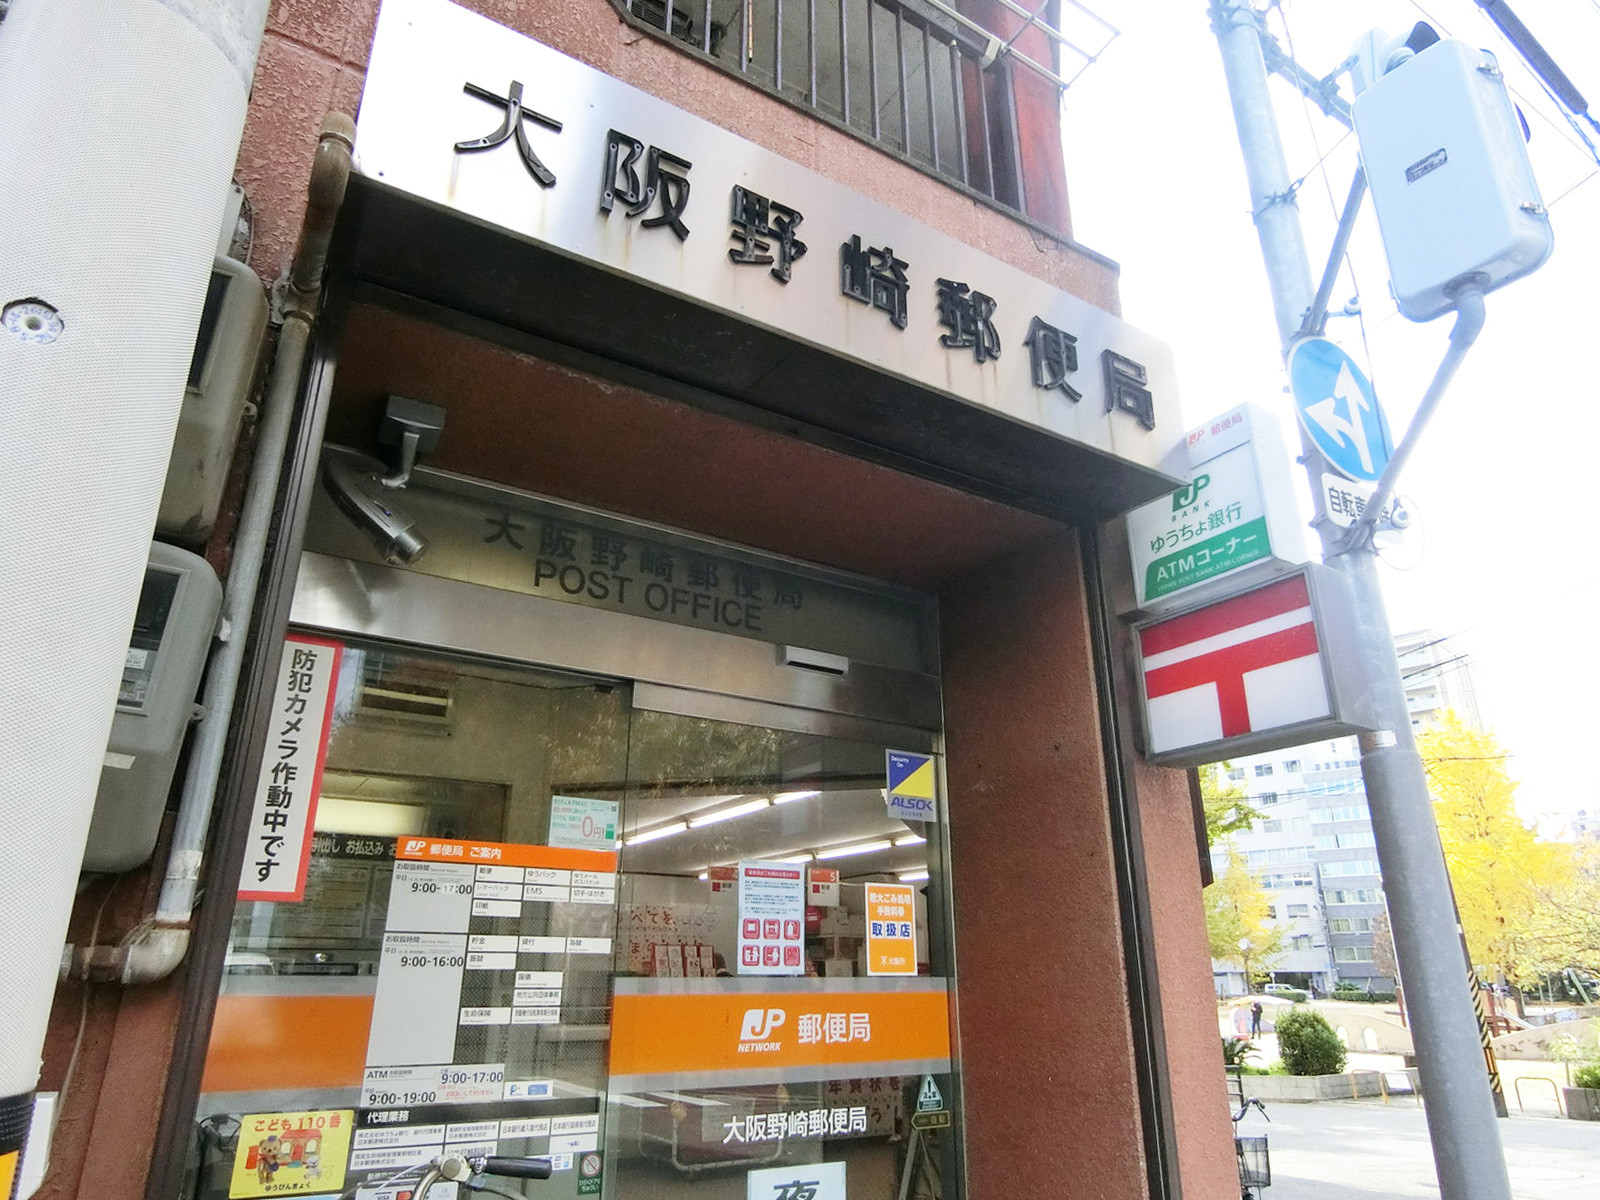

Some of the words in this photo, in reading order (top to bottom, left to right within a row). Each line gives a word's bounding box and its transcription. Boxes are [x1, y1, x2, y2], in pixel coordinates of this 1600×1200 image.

[453, 80, 1156, 432] 大阪野崎郵便局
[1171, 500, 1210, 522] BANK
[1150, 501, 1243, 555] ゆうちょ銀行
[483, 512, 804, 610] 大阪野崎郵便局
[1156, 533, 1258, 583] ATMコーナー
[533, 558, 634, 604] POST
[644, 582, 763, 632] OFFICE
[254, 648, 318, 883] 防犯カメラ作動中です
[890, 796, 934, 811] ALSOK
[345, 839, 385, 856] お払込み
[429, 843, 464, 856] 郵便局
[469, 846, 502, 859] ご案内
[525, 887, 543, 895] EMS
[871, 921, 911, 938] 取扱店
[401, 956, 464, 967] 9:00-16:00
[739, 1008, 786, 1041] JP
[798, 1012, 871, 1045] 郵便局
[737, 1042, 781, 1053] NETWORK
[366, 1070, 388, 1079] ATM
[441, 1071, 504, 1084] 9:00-17:00
[369, 1091, 437, 1106] 9:00-19:00
[367, 1109, 410, 1124] 代理業務
[722, 1106, 867, 1145] 大阪野崎郵便局
[264, 1181, 312, 1192] ゆうびんきょく
